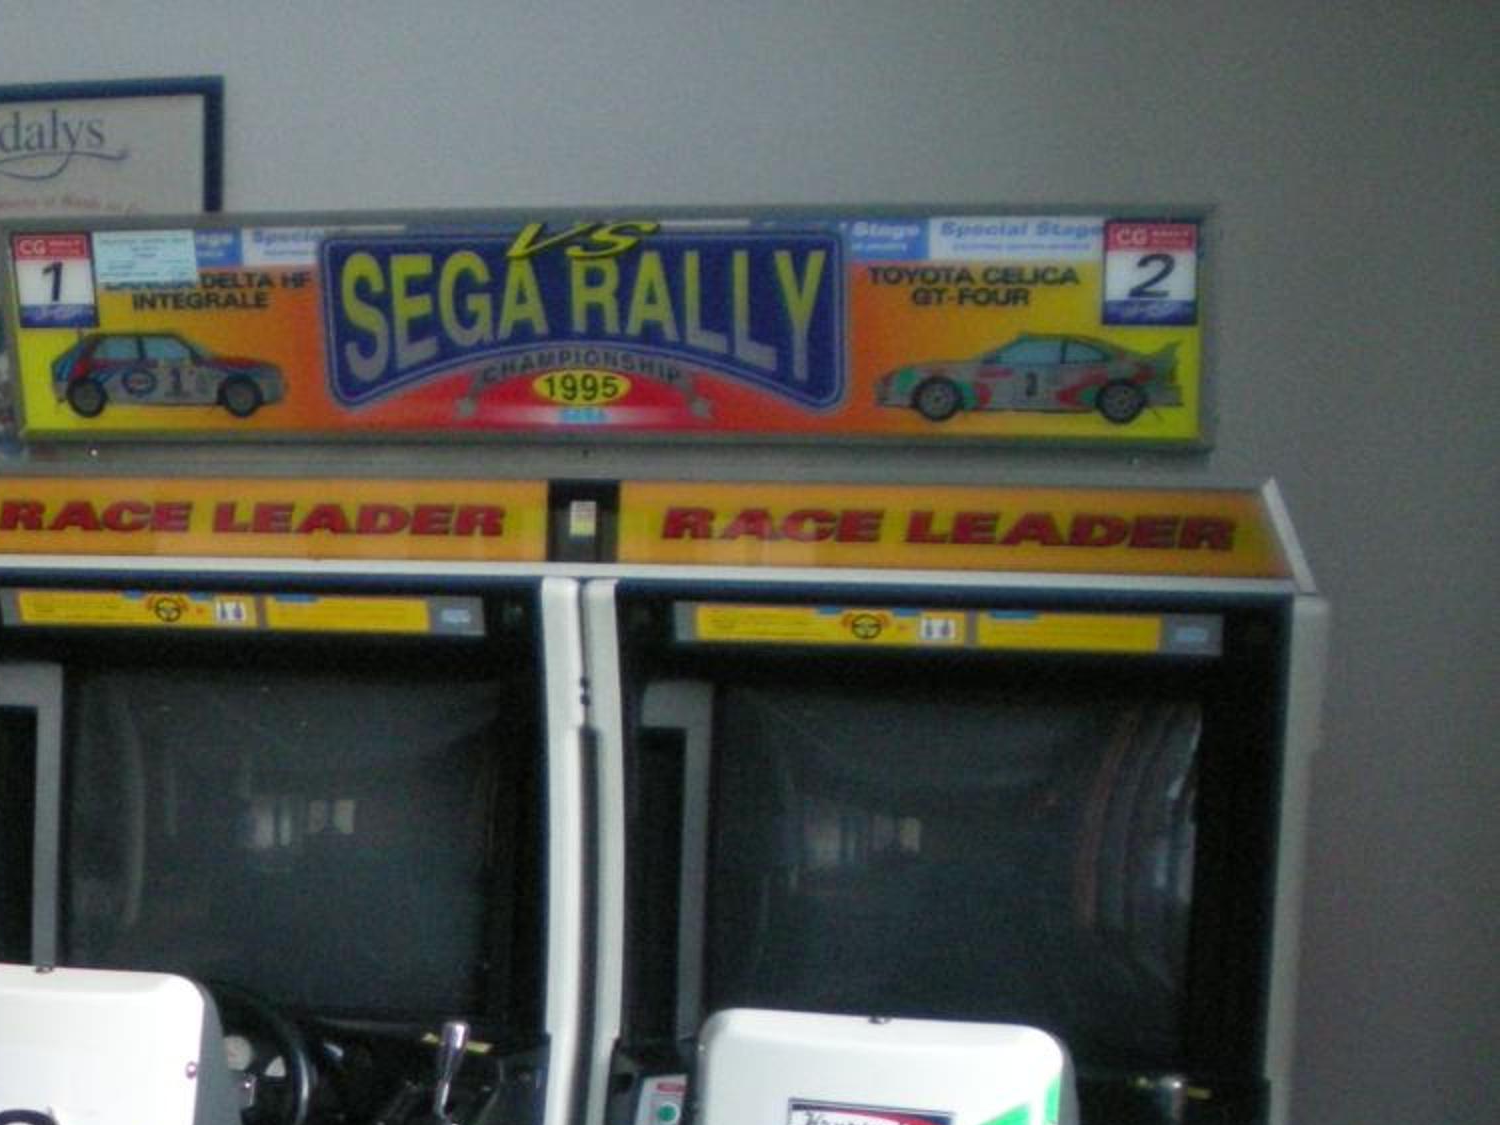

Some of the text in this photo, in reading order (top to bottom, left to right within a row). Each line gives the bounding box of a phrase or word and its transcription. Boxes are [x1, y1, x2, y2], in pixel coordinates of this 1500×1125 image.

[507, 219, 662, 261] VS
[852, 221, 919, 239] Stage
[940, 221, 1102, 240] Special Stage
[1116, 228, 1149, 247] CG
[19, 239, 47, 257] CG
[42, 261, 64, 303] 1
[201, 271, 272, 289] DELTA
[280, 271, 311, 288] HF
[868, 266, 1080, 286] TOYOTA CELICA
[1127, 253, 1177, 300] 2
[132, 292, 268, 310] INTEGRALE
[911, 287, 1032, 306] GT-FOUR
[341, 249, 826, 383] SEGA RALLY
[480, 347, 681, 385] CHAMPIONSHIP
[543, 374, 621, 402] 1995
[211, 500, 506, 537] LEADER
[661, 504, 1237, 551] RACE LEADER
